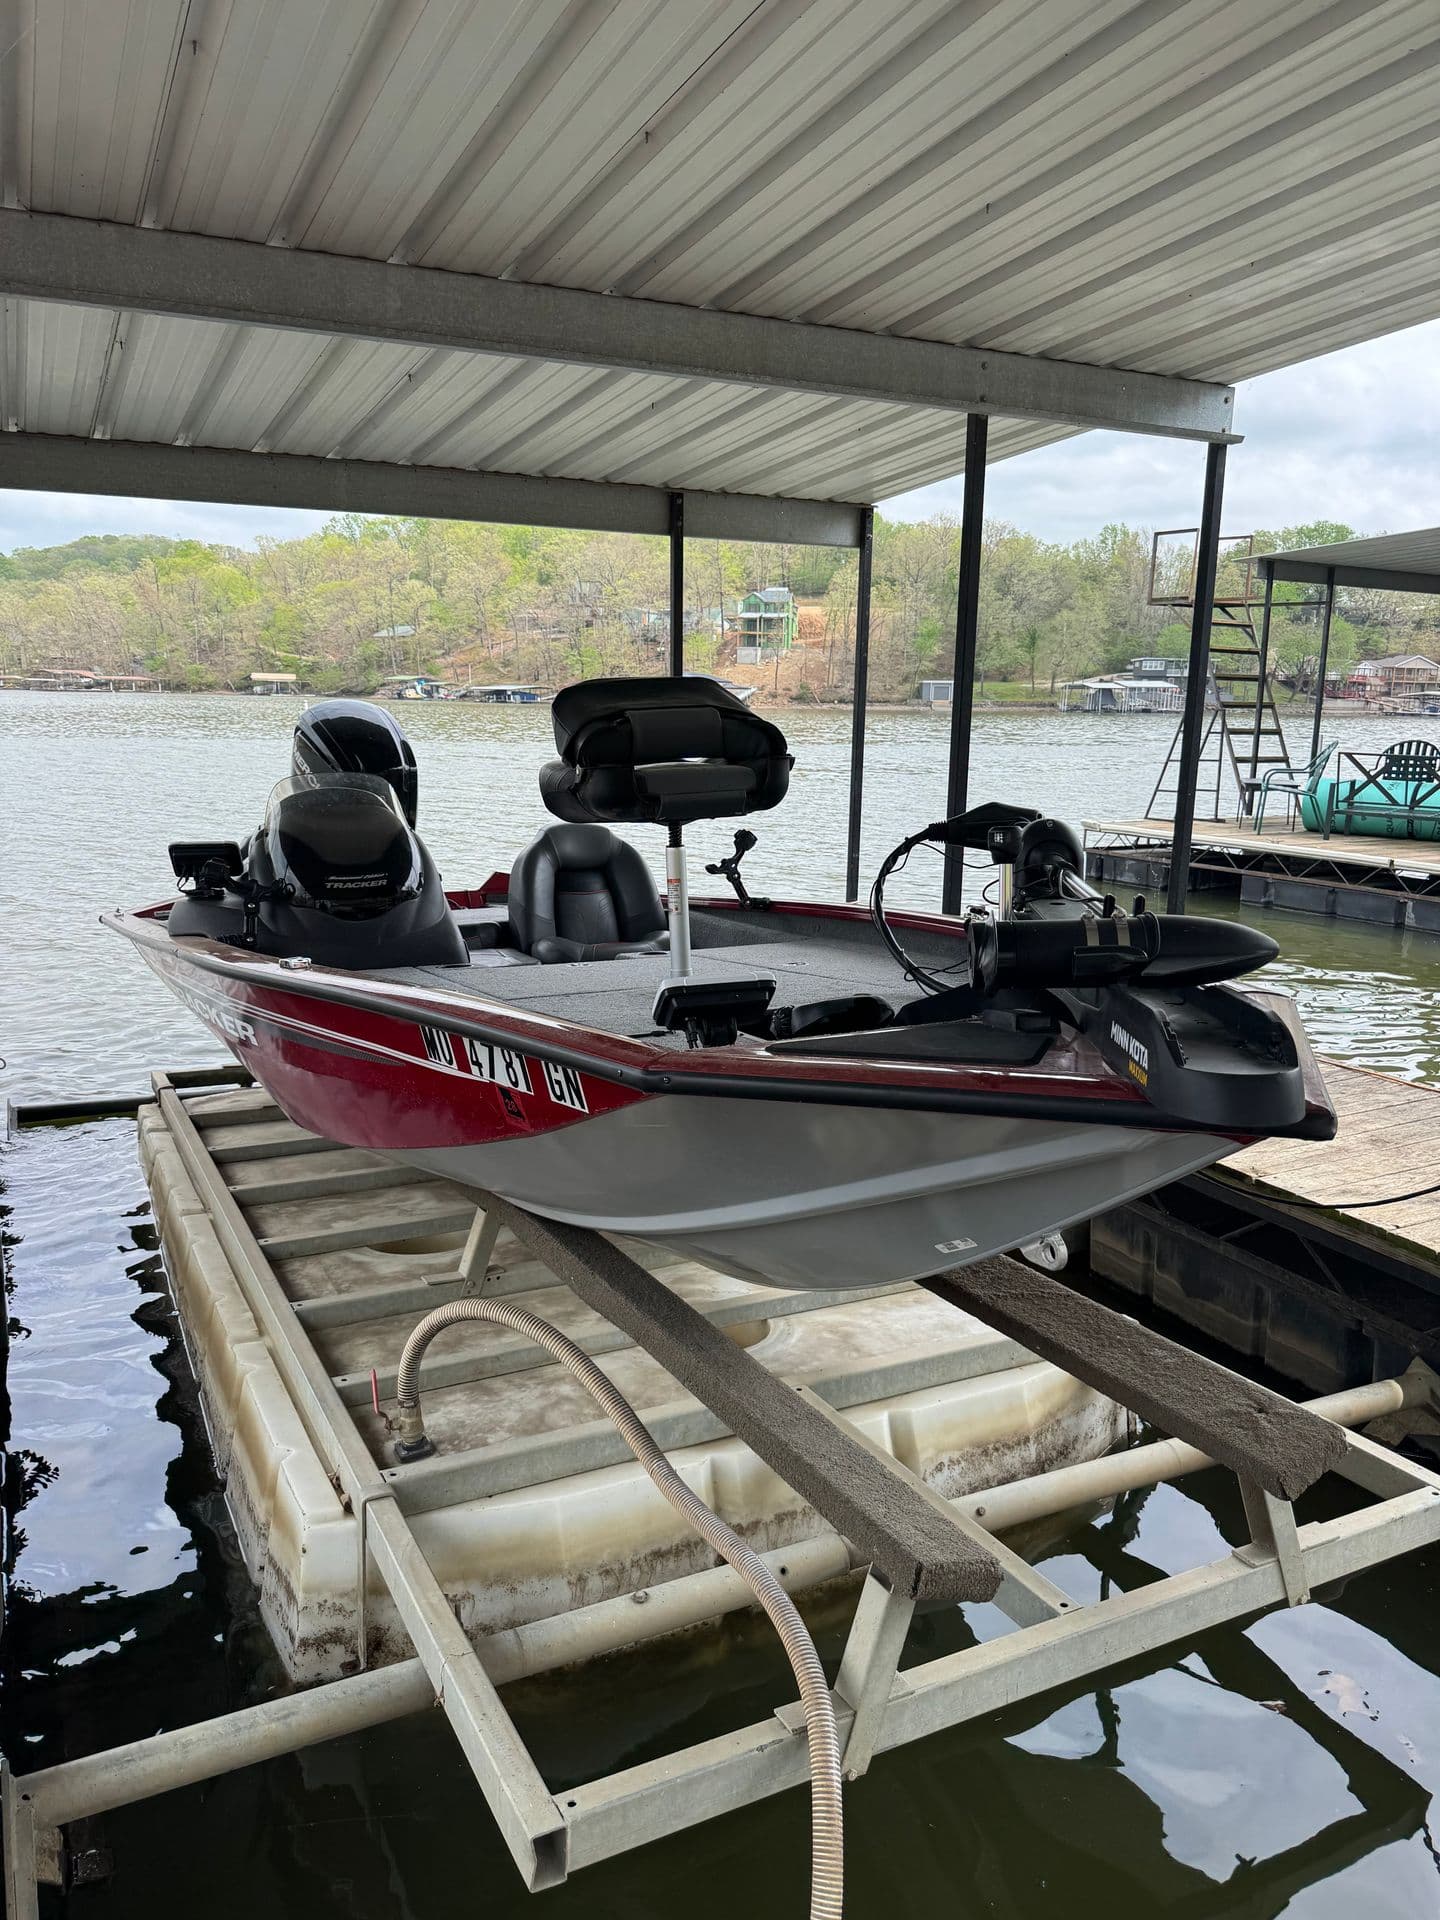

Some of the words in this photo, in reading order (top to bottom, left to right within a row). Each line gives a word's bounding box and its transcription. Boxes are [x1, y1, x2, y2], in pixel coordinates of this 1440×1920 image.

[324, 879, 387, 889] TRACKER
[1110, 1020, 1130, 1053] MINN
[1129, 1035, 1149, 1071] KOTA
[469, 1039, 532, 1093] 4781
[544, 1062, 586, 1111] GN
